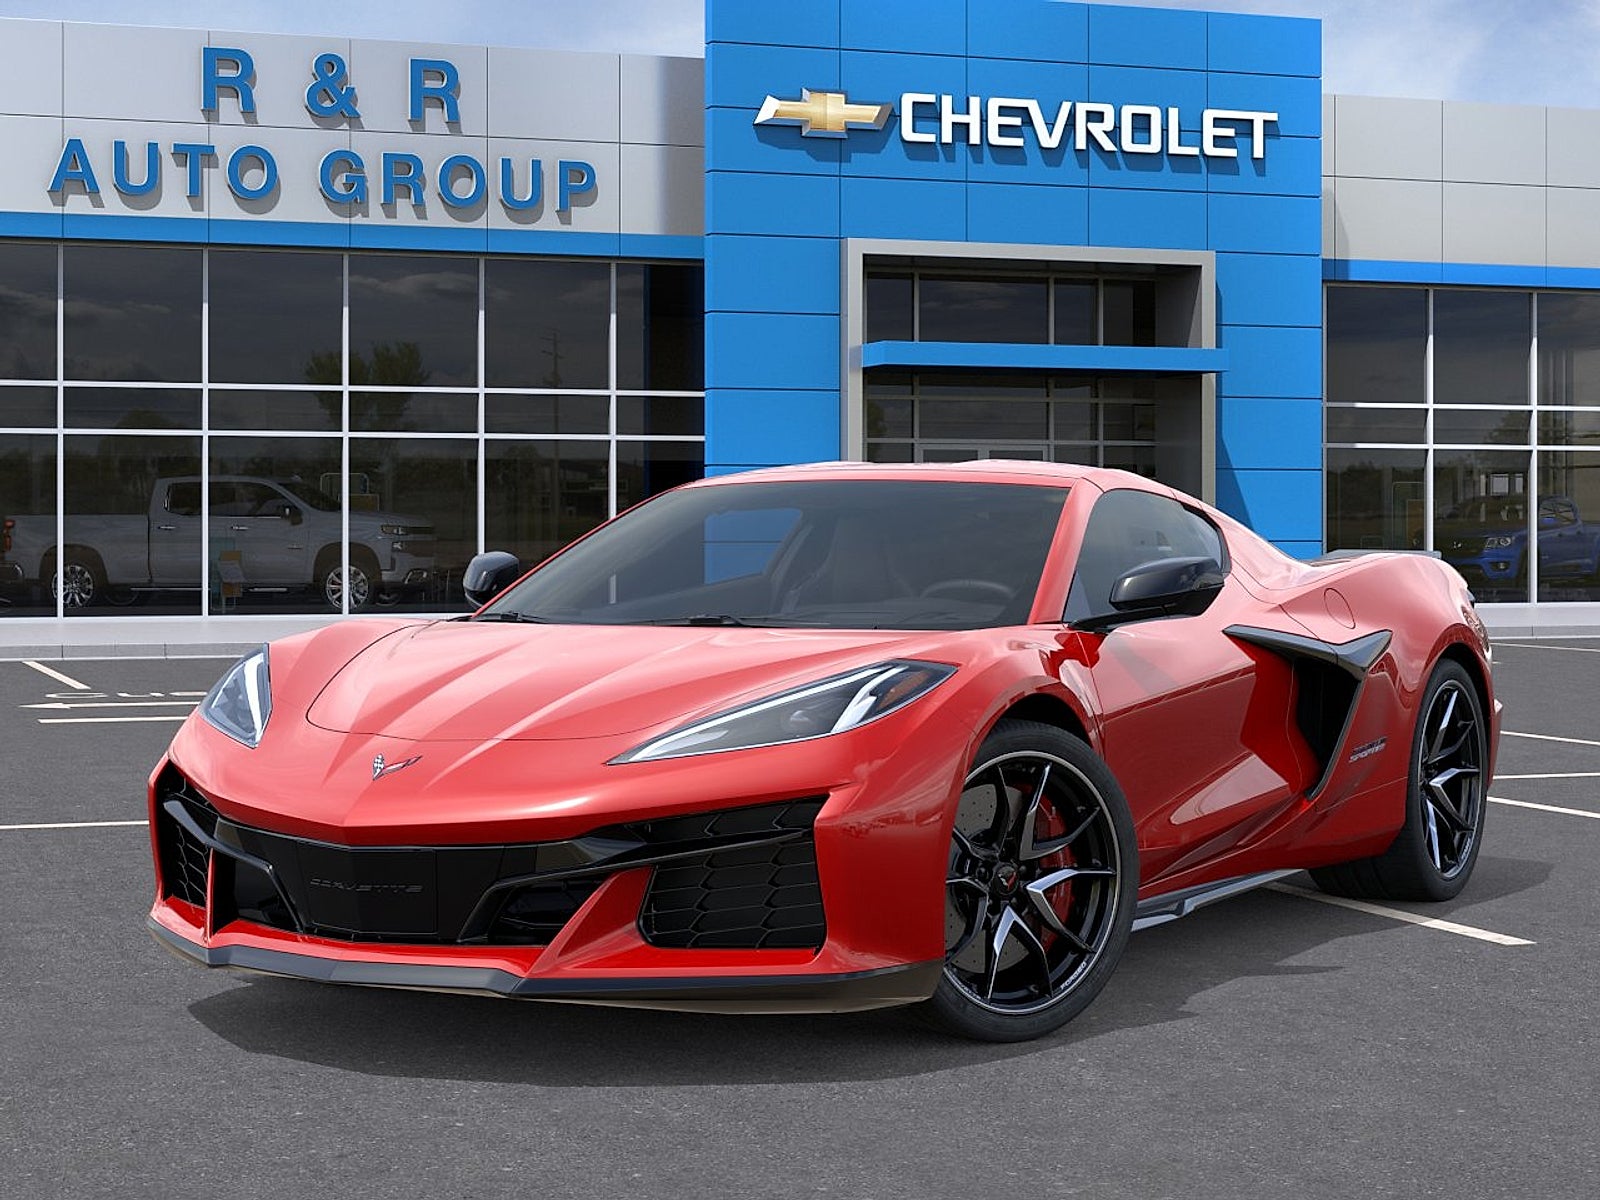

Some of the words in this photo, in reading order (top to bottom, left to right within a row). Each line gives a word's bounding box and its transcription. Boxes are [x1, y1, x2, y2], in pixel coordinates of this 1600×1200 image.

[201, 46, 255, 113] R
[304, 52, 359, 119] &
[408, 57, 461, 123] R
[900, 92, 1279, 160] CHEVROLET
[47, 137, 280, 200] AUTO
[318, 148, 597, 212] GROUP
